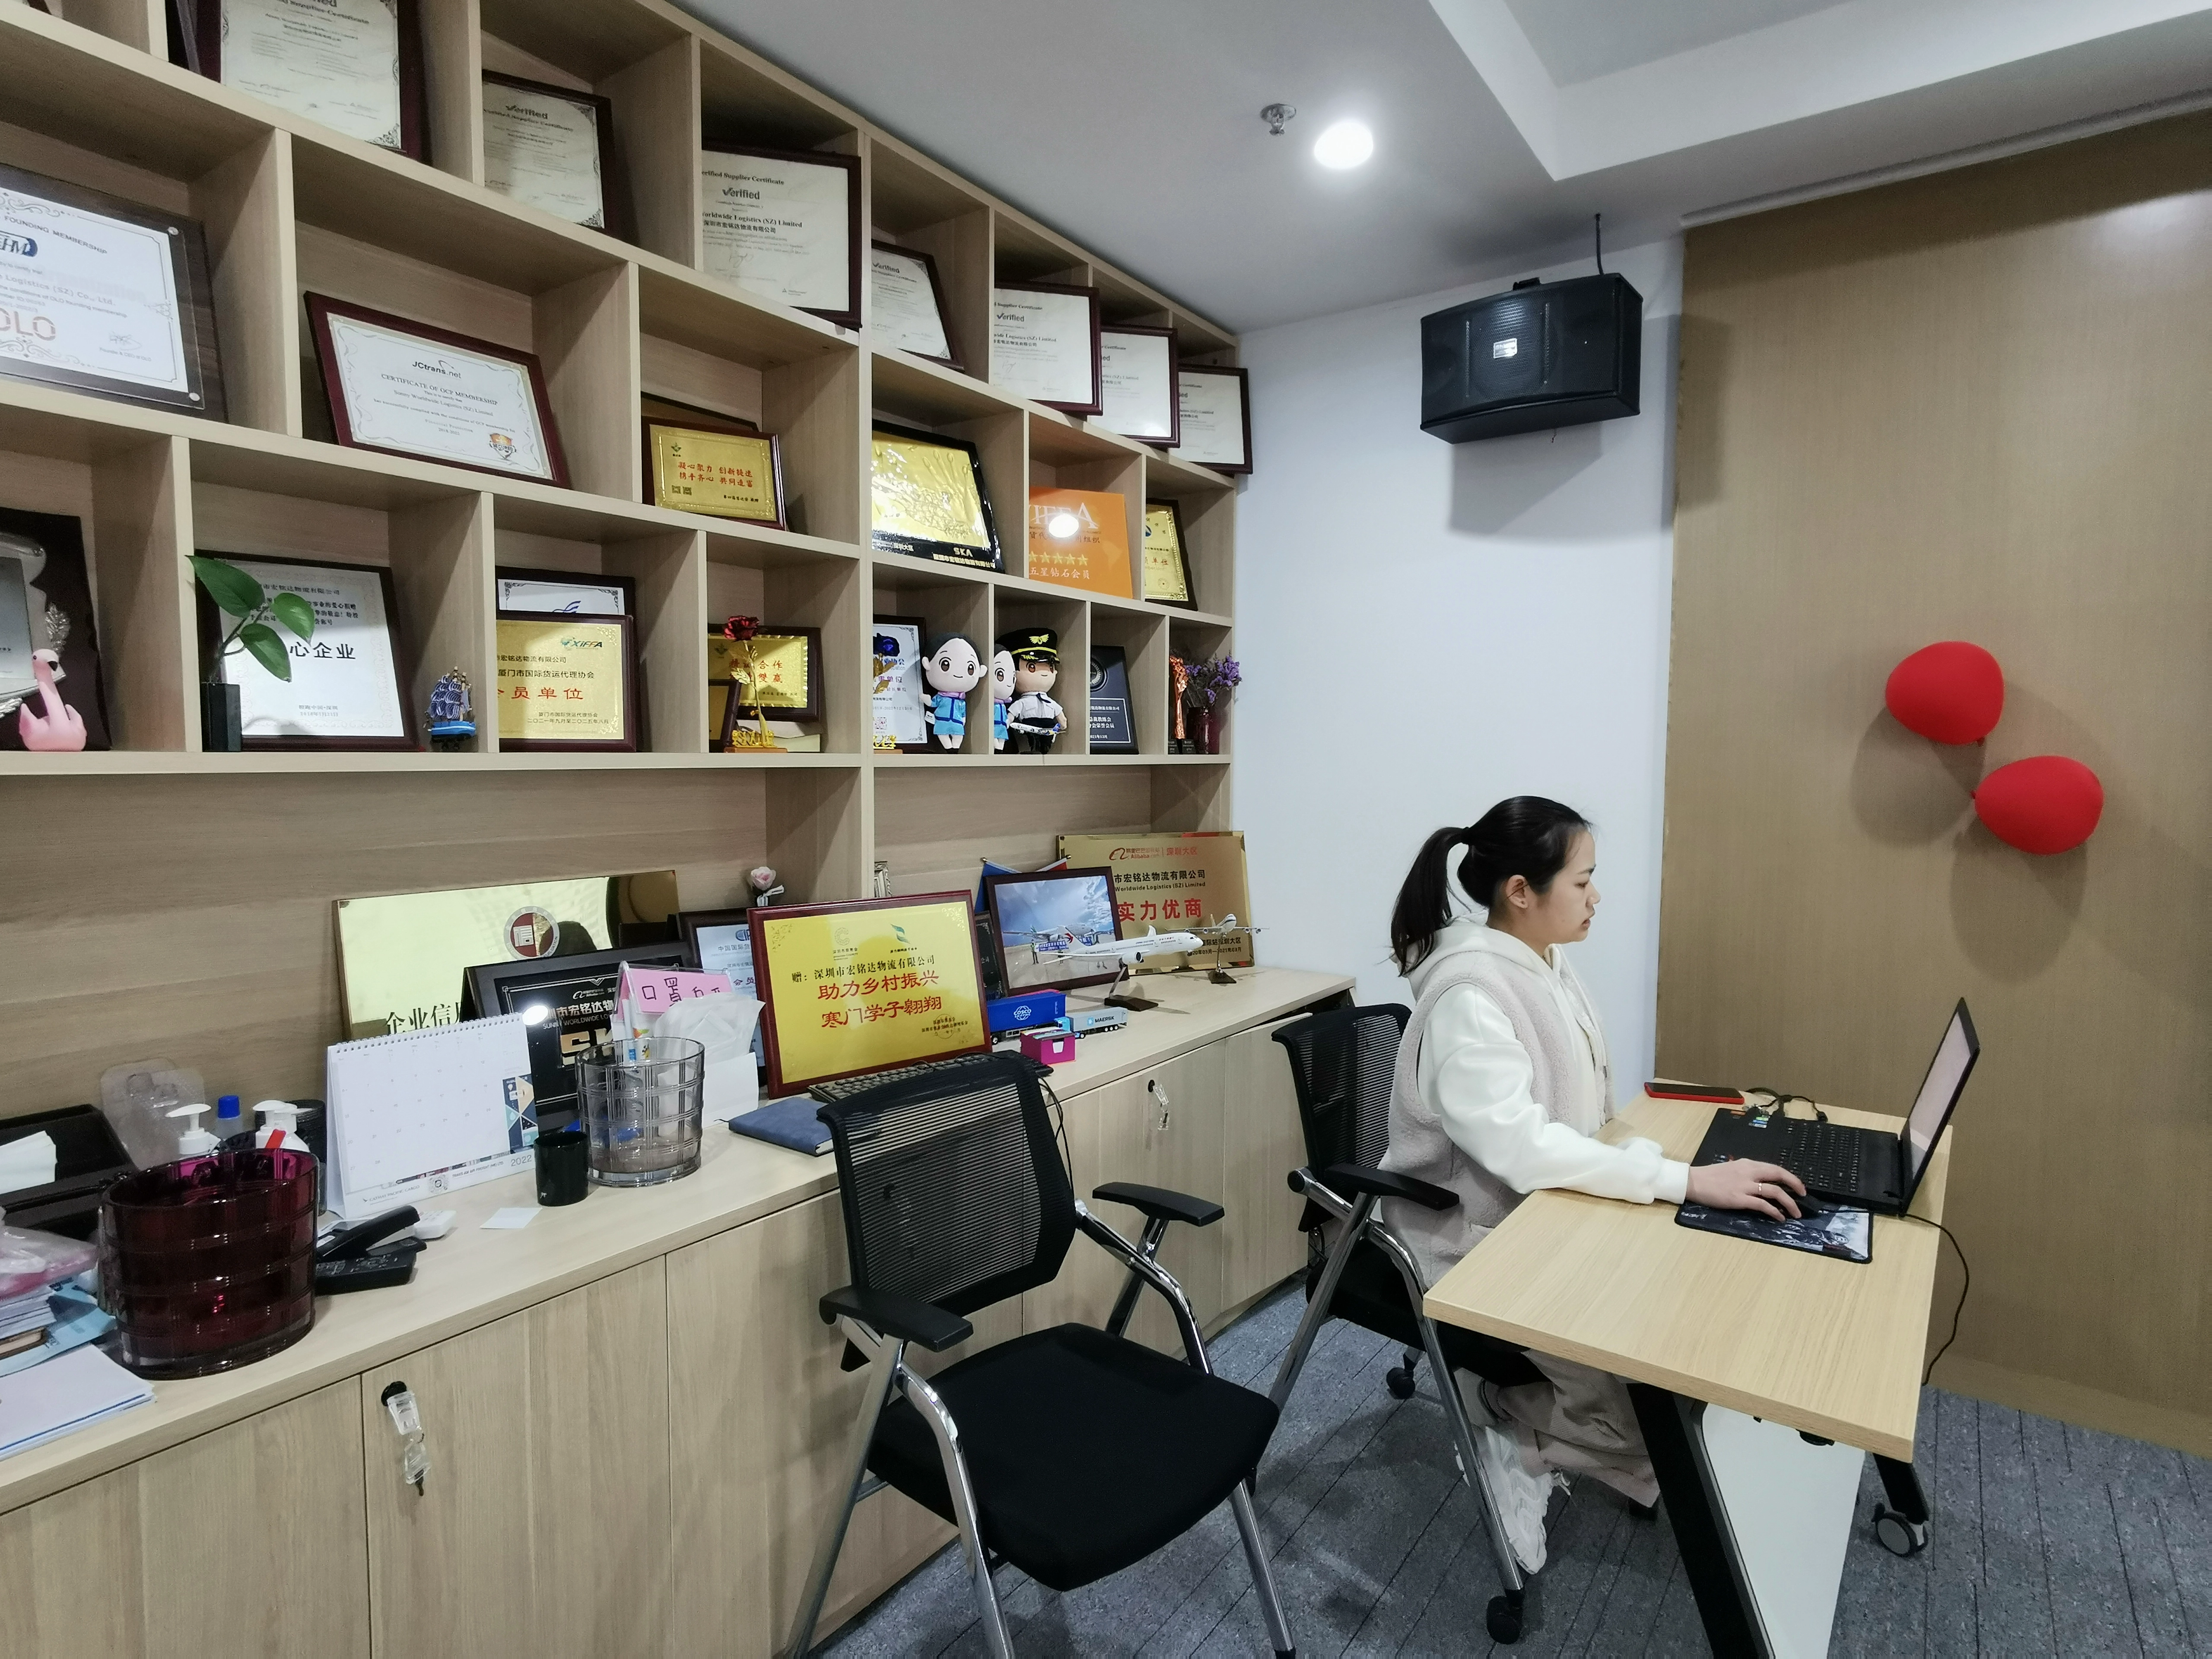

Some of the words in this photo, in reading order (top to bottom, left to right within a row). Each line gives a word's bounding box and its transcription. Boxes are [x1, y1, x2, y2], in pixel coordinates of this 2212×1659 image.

[724, 171, 751, 181] Supplier
[752, 176, 784, 185] Certificate
[722, 188, 760, 200] Verified
[4, 216, 49, 233] FOUNDING
[53, 230, 107, 254] MEMBERSHIP
[5, 276, 49, 290] Logistics
[53, 286, 74, 297] (SZ)
[997, 313, 1024, 322] Verified
[412, 361, 462, 379] JCtrans.net
[381, 373, 428, 389] CERTIFICATE
[455, 391, 498, 405] MEMBERSHIP
[953, 547, 973, 557] SKA
[1029, 567, 1090, 579] 五星钻石会员
[498, 670, 594, 679] 厦门市国际货运代理协会
[1167, 847, 1198, 856] 深圳大区
[1114, 870, 1205, 884] 市宏铭达物流有限公司
[1117, 898, 1202, 922] 实力优商
[814, 955, 935, 980] 深圳市宏铭达物流有限公司
[818, 970, 939, 1000] 助力乡村振兴
[822, 996, 941, 1027] 寒门学子翱翔
[563, 1015, 599, 1026] WORLDWIDE
[511, 1155, 532, 1166] 2022
